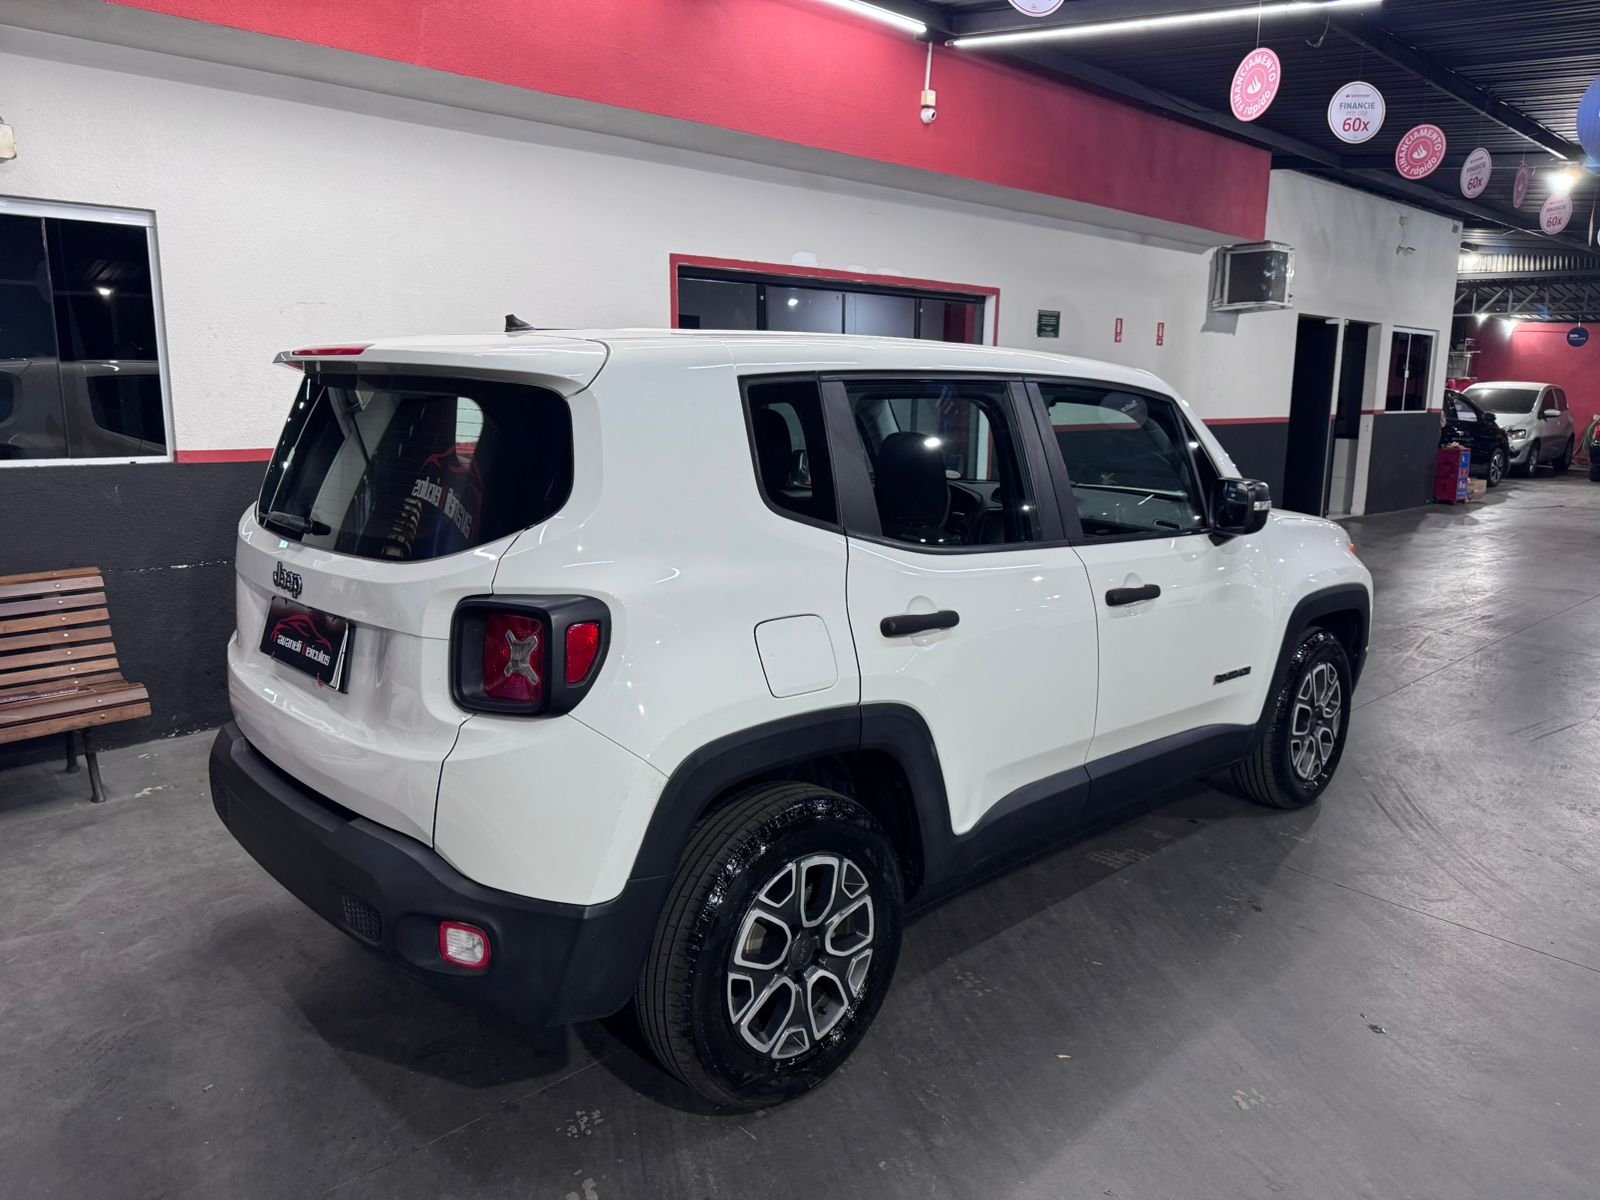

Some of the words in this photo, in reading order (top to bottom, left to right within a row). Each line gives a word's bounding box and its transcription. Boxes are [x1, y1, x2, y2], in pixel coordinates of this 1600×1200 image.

[1234, 54, 1276, 111] FINANCIAMENTO
[1340, 102, 1375, 110] FINANCIE
[1342, 117, 1370, 132] 60x
[1399, 128, 1442, 172] FINANCIAMENTO
[1467, 176, 1483, 190] 60x
[1546, 216, 1563, 227] 60x
[273, 561, 303, 599] Jeep
